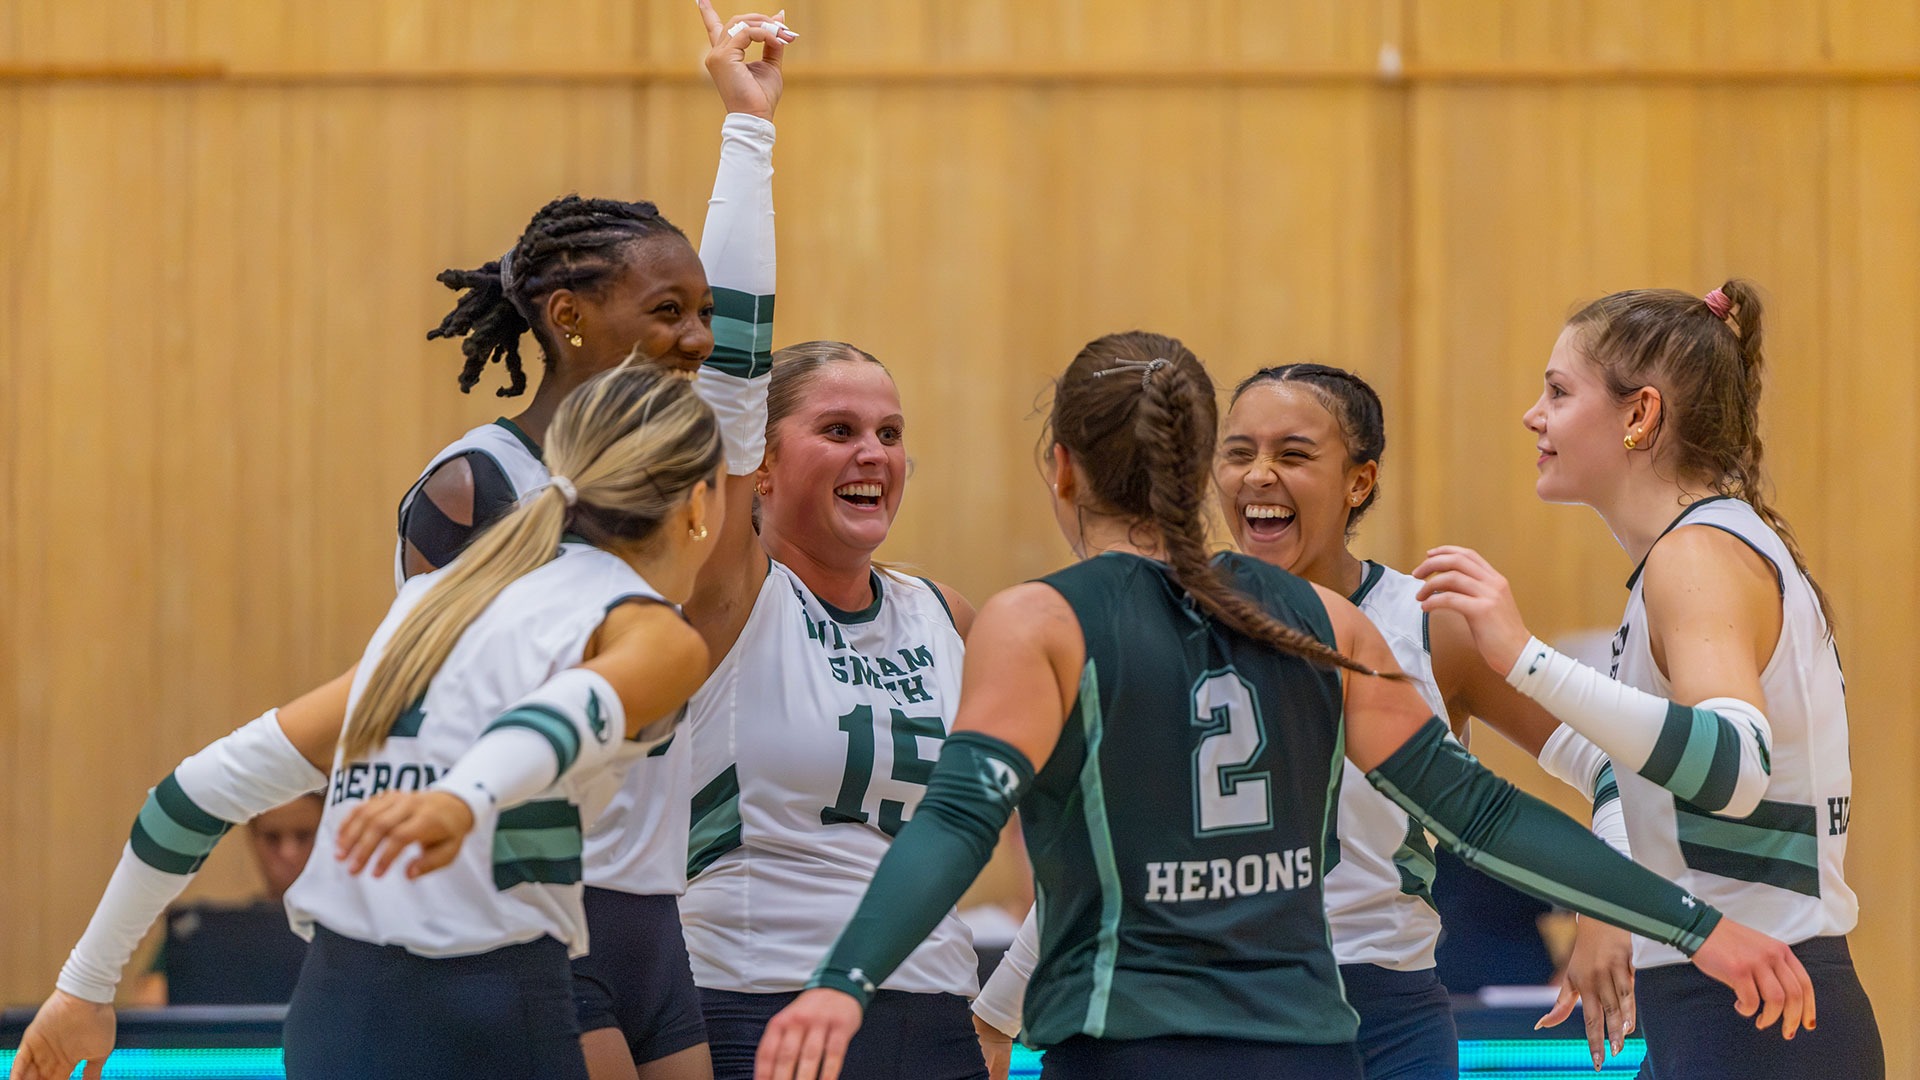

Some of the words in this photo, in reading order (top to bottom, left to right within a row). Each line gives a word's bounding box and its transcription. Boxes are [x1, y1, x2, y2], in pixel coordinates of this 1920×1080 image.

[828, 655, 934, 706] SMH
[820, 703, 947, 838] 15
[1190, 664, 1274, 838] 2
[331, 762, 451, 807] HERO
[1145, 846, 1313, 903] HERONS
